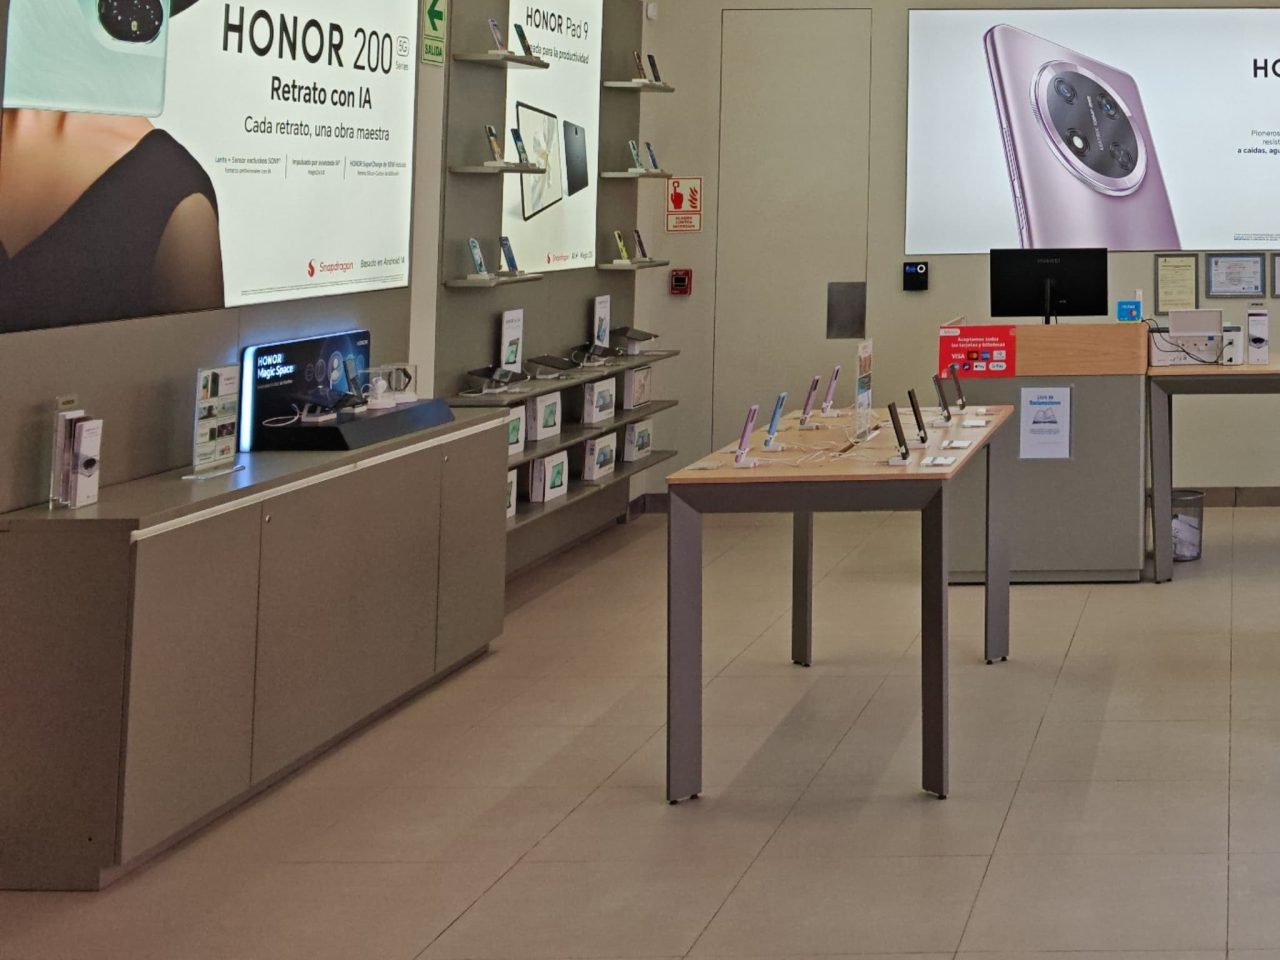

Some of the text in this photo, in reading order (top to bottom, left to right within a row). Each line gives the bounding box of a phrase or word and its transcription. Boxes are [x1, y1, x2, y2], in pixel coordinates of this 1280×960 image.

[525, 6, 589, 40] HONOR Pad 9
[222, 3, 344, 67] HONOR
[353, 28, 393, 74] 200
[424, 44, 442, 56] SALIDA
[271, 76, 372, 109] Retrato con IA
[244, 115, 390, 141] Cada retrato, una obra maestra
[319, 261, 354, 274] Snapdragon
[257, 353, 282, 366] HONOR
[257, 364, 294, 379] Magic Space
